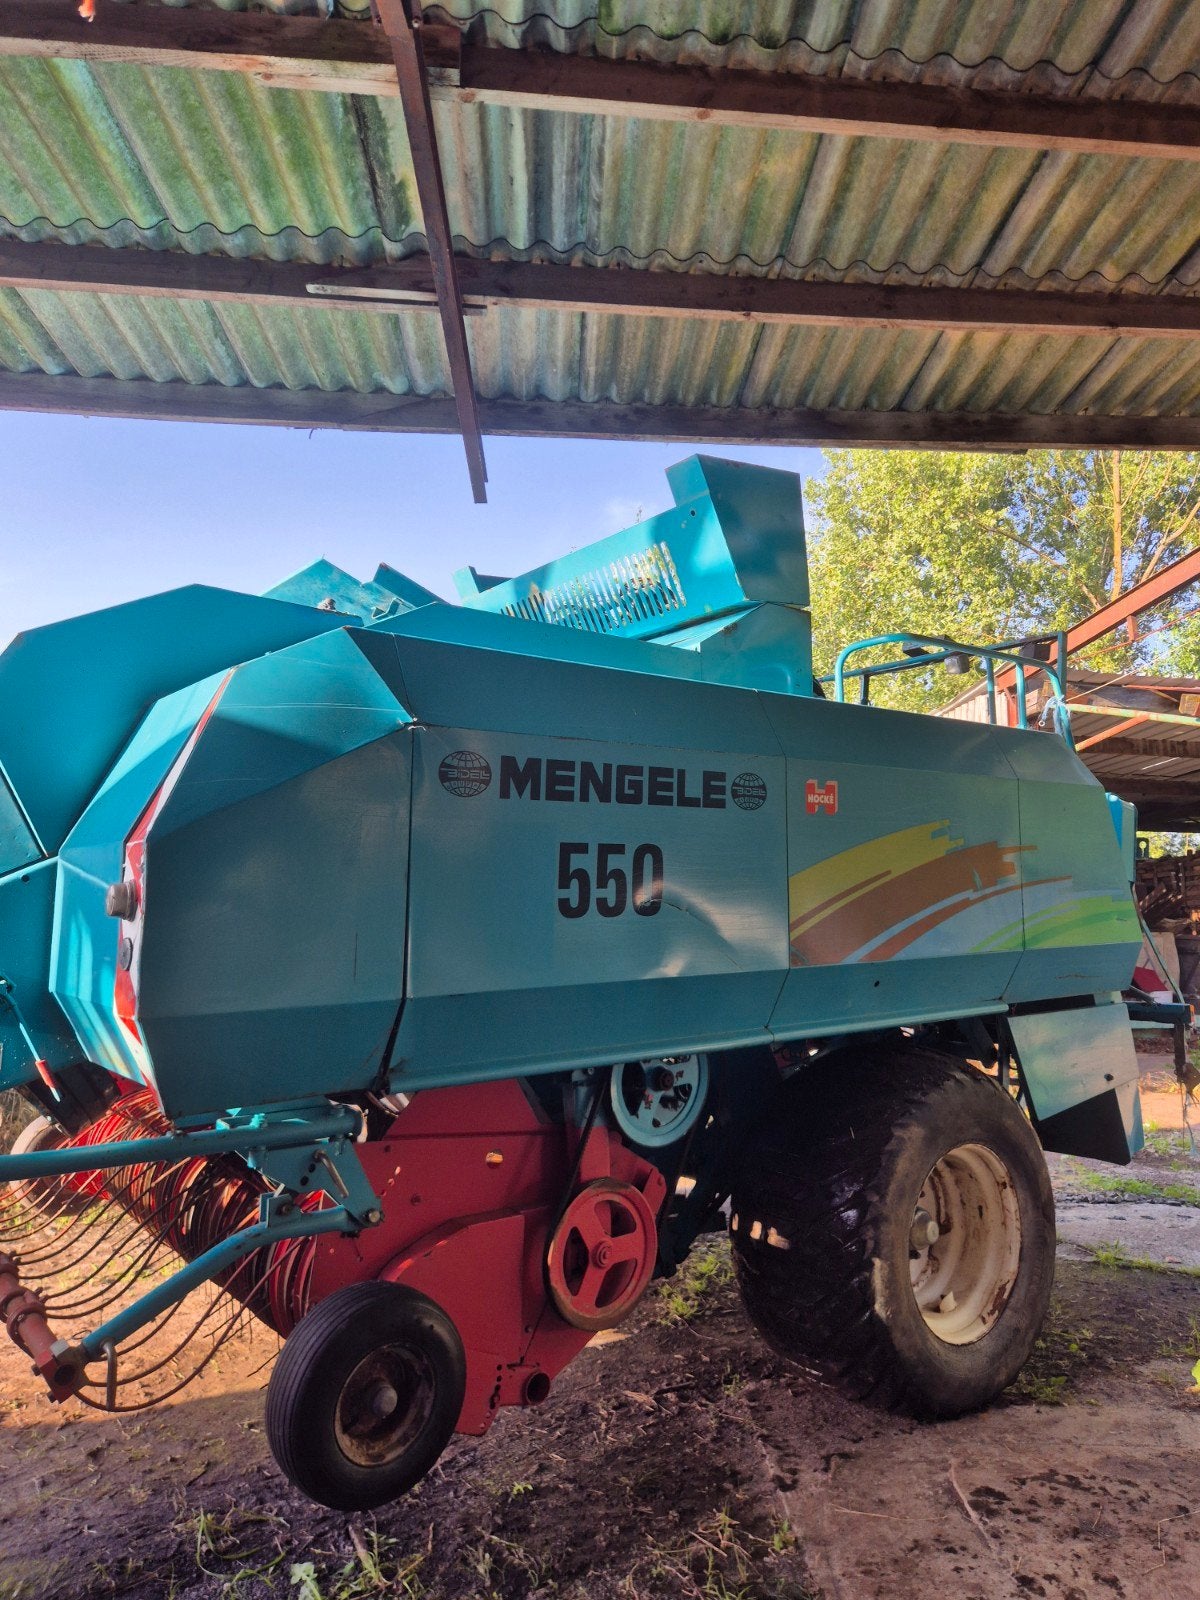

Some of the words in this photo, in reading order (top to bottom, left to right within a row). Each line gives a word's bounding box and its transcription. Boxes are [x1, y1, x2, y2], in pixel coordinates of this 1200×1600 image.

[500, 755, 726, 809] MENGELE
[807, 793, 834, 804] HOCKÉ
[558, 842, 664, 918] 550
